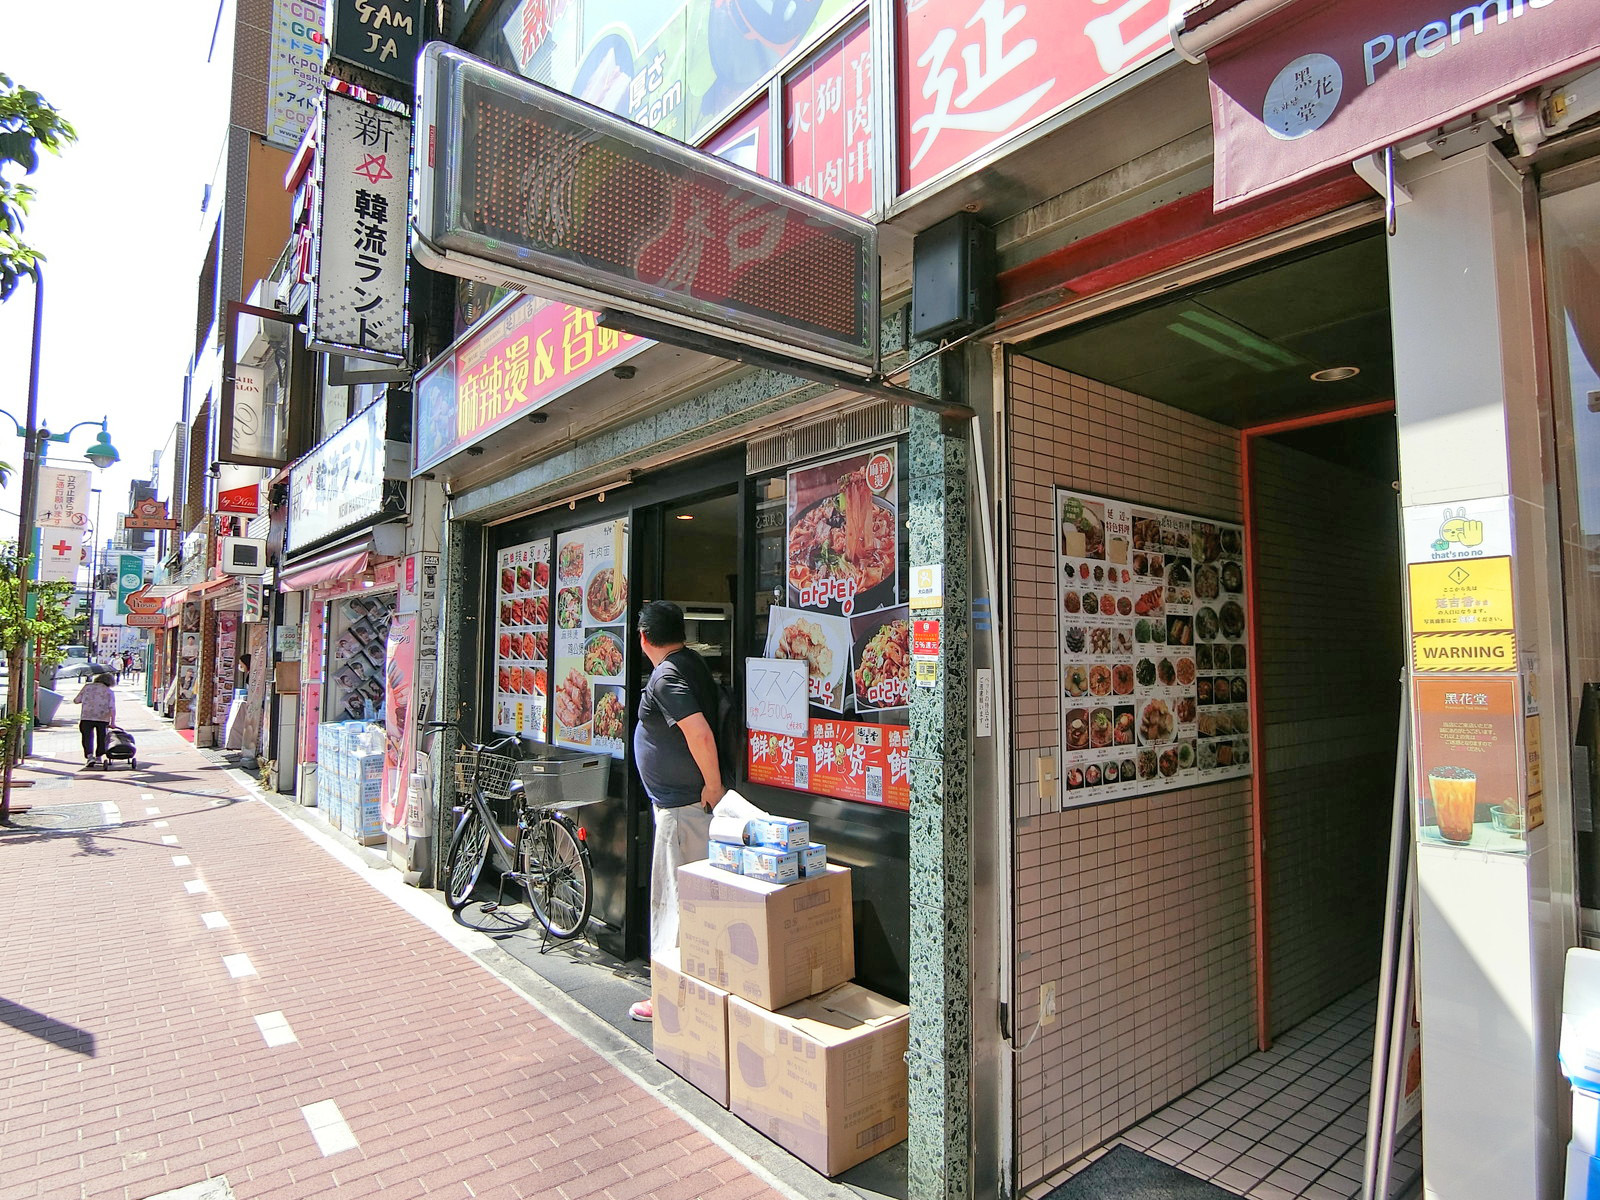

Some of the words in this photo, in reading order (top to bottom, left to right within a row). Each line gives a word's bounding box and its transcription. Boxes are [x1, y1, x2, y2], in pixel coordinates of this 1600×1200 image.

[354, 0, 413, 36] GAM
[363, 31, 398, 63] JA
[353, 110, 395, 154] 新
[354, 189, 390, 347] 韓流ランド
[220, 496, 231, 508] by
[1431, 551, 1457, 560] that's
[1458, 550, 1470, 558] no
[1471, 549, 1483, 557] no
[801, 578, 856, 614] 마라탕
[1423, 645, 1505, 659] WARNING
